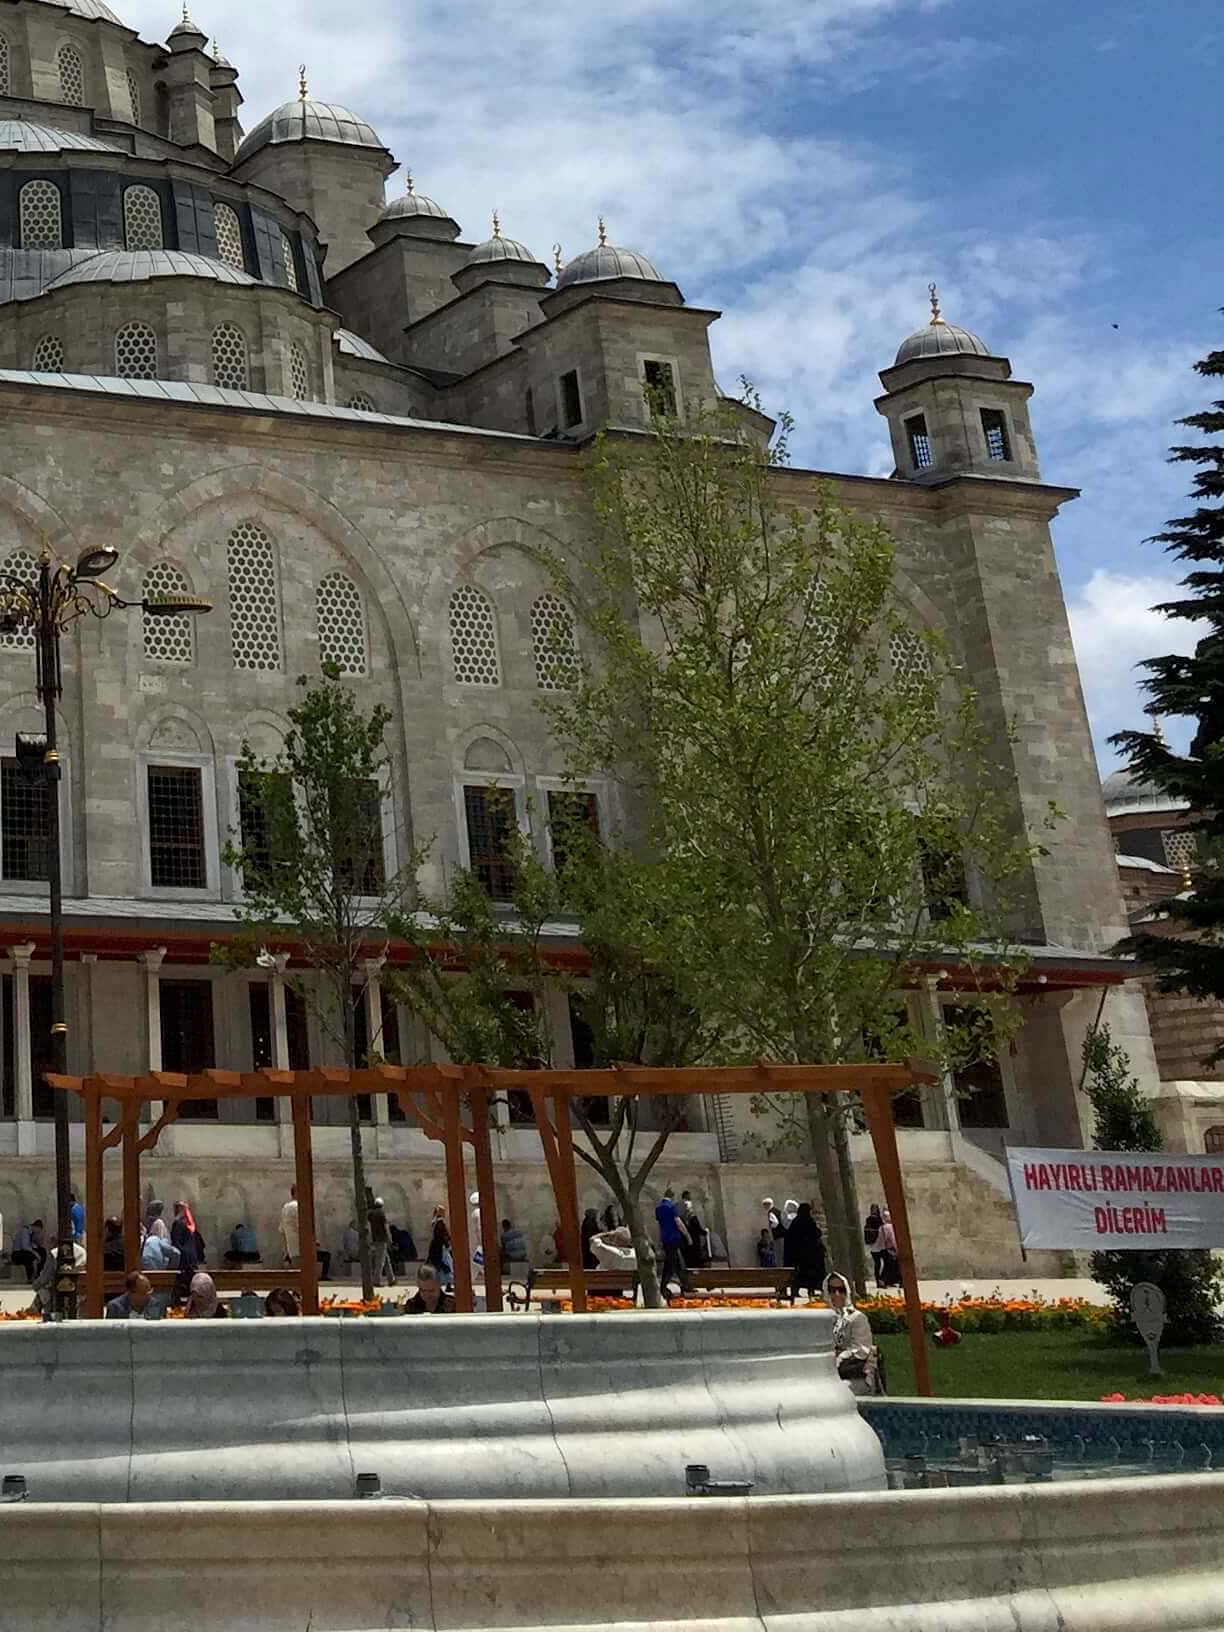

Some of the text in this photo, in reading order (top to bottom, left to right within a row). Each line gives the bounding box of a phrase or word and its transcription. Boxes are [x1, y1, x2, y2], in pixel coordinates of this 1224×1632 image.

[1023, 1163, 1224, 1192] HAYIRLI RAMAZANLAR
[1094, 1200, 1168, 1234] DİLERİM
